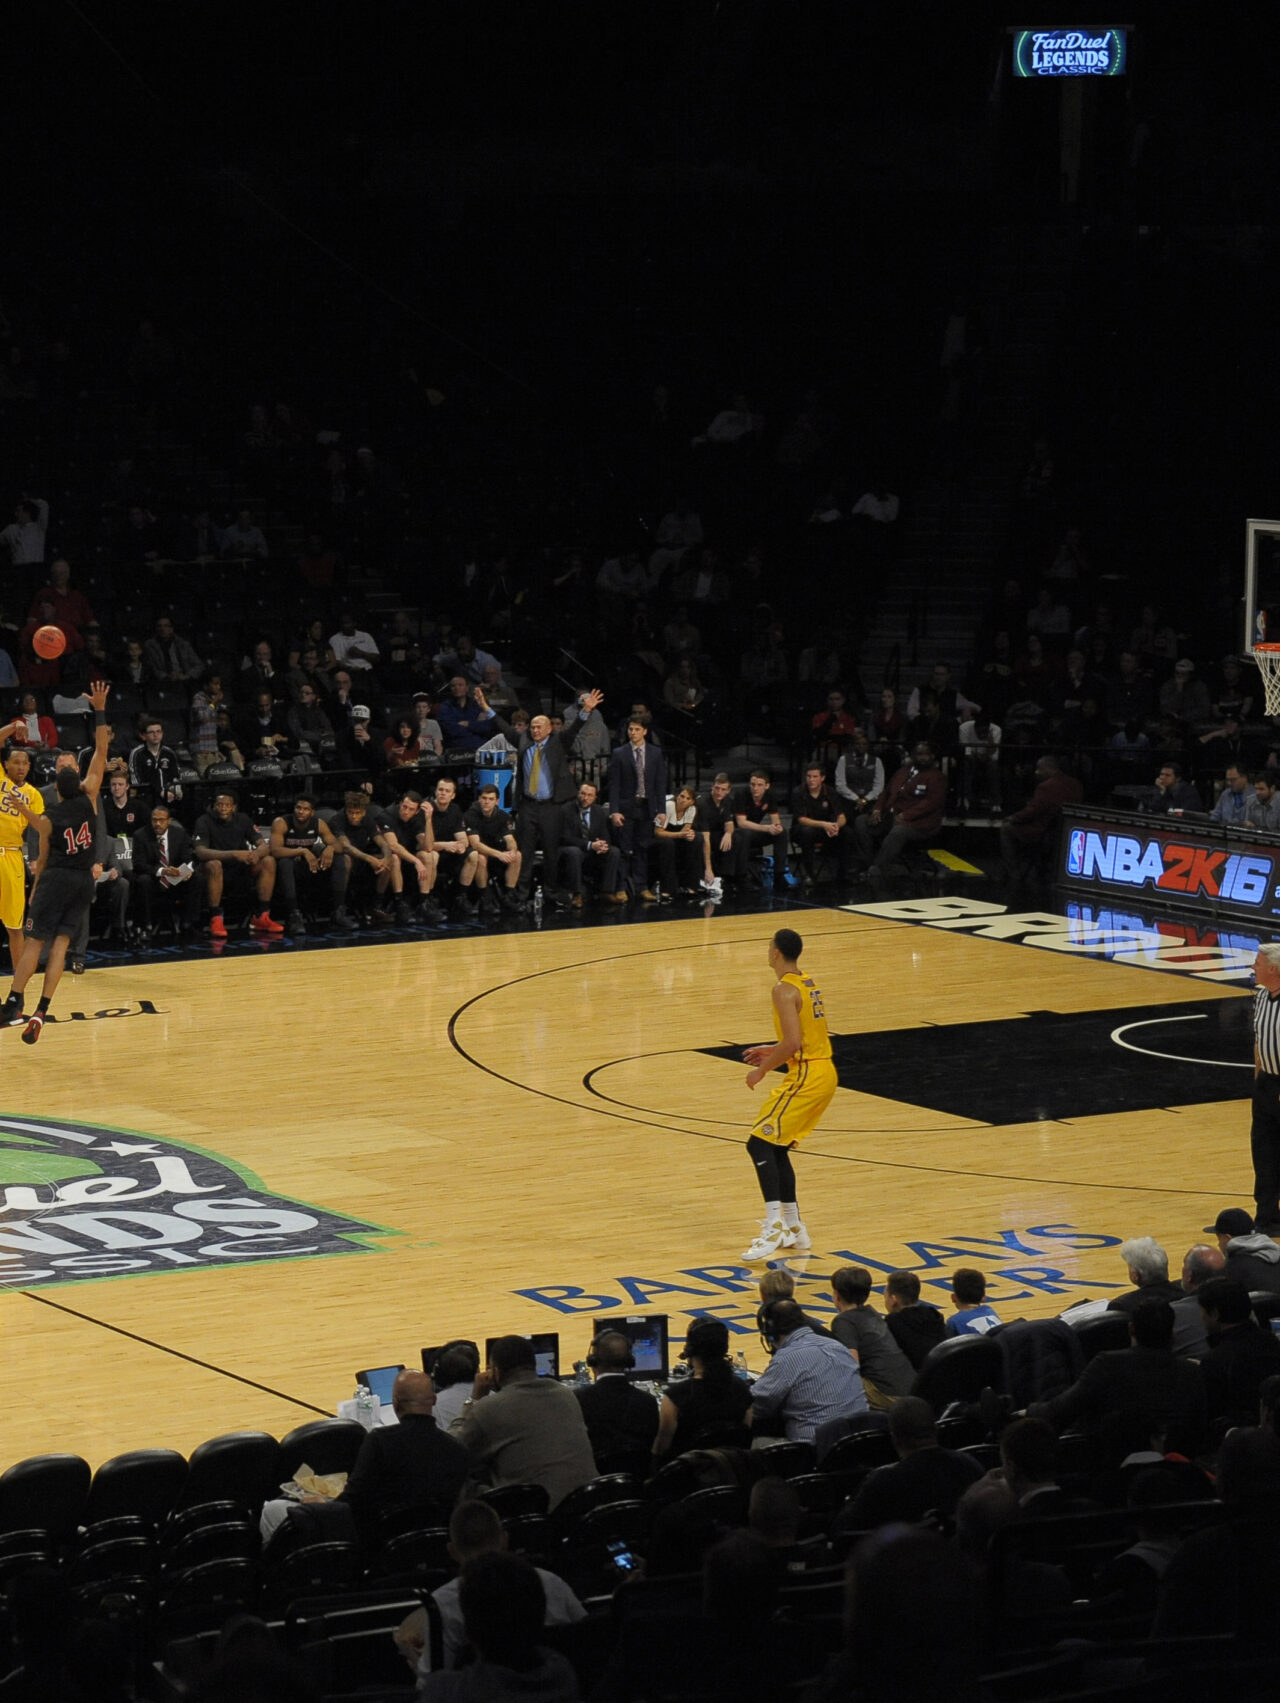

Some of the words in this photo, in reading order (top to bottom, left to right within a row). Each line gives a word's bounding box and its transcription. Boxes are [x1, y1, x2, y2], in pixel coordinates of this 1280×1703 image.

[1032, 32, 1111, 51] FanDuel
[1032, 50, 1109, 69] LEGENDS
[1038, 66, 1102, 75] CLASSIC
[64, 821, 92, 855] 14
[838, 897, 1266, 981] BROO
[507, 1223, 1124, 1314] BARCLAYS
